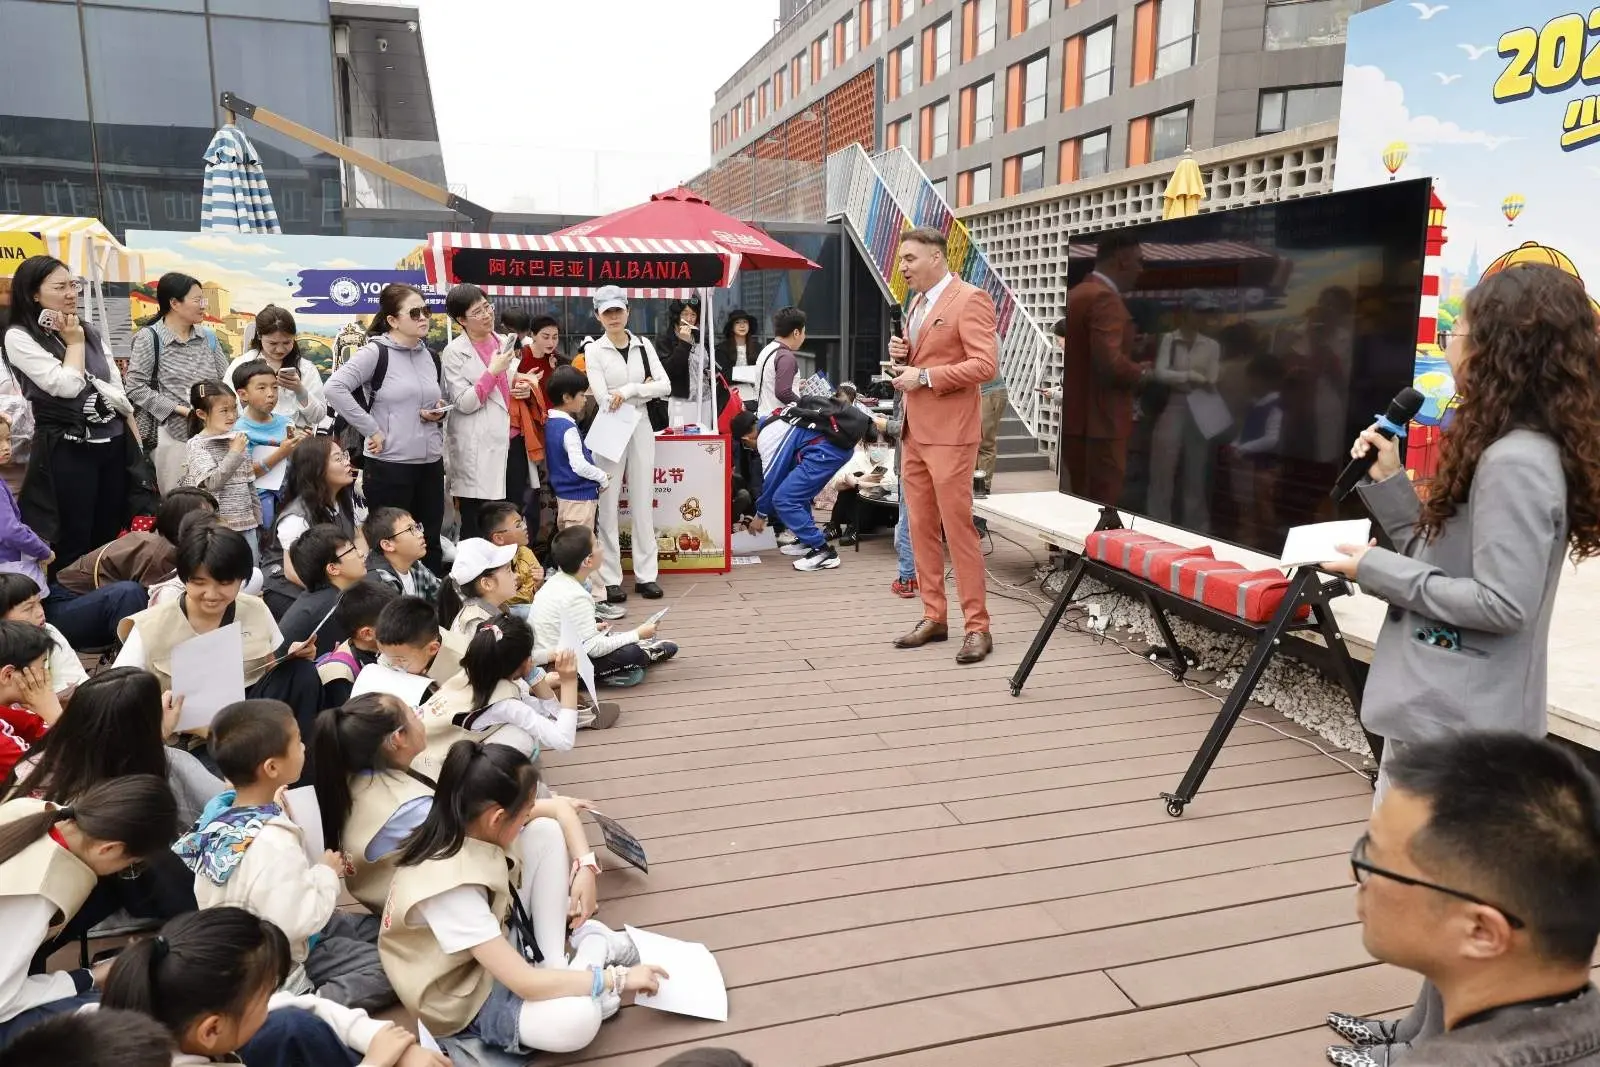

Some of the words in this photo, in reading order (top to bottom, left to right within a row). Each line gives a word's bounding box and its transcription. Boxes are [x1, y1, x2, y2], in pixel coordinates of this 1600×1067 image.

[489, 258, 585, 277] 阿尔巴尼亚
[599, 260, 691, 281] ALBANIA
[653, 467, 685, 484] 化节
